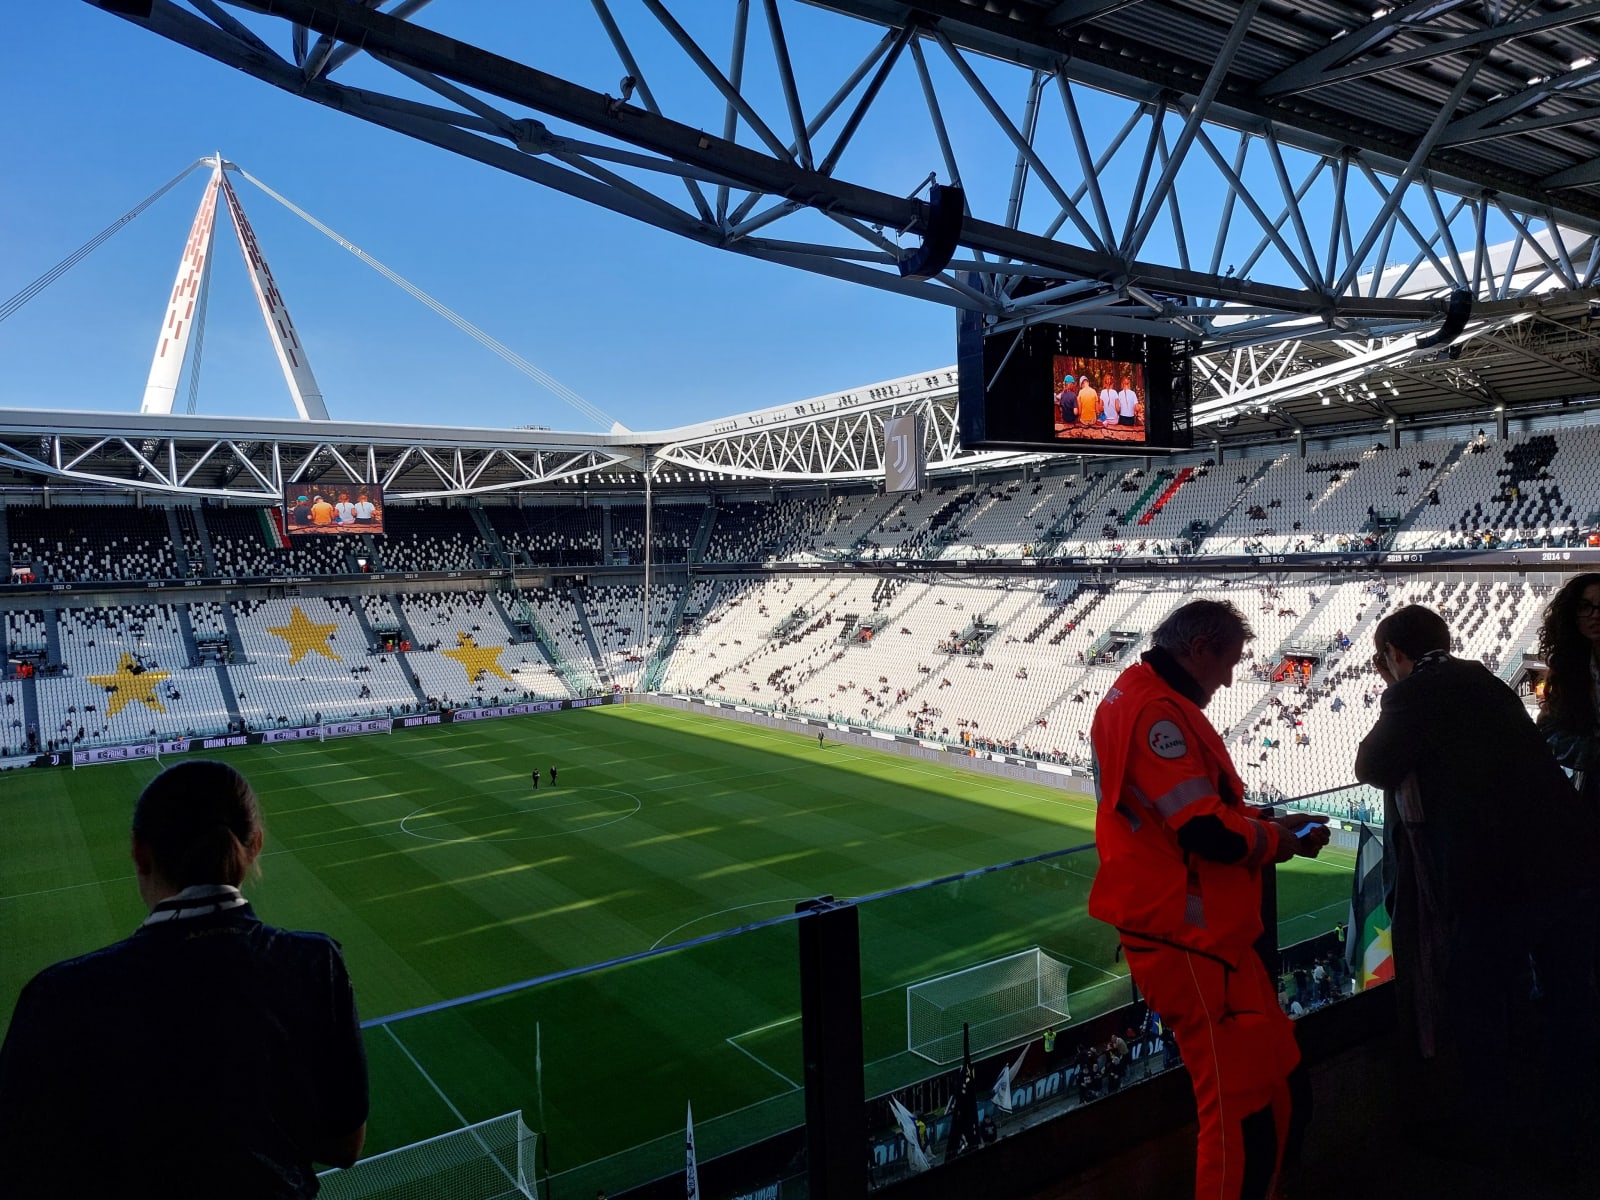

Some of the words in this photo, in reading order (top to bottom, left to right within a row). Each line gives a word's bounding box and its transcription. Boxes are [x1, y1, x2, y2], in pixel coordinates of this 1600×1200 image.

[1542, 553, 1560, 561] 2014
[404, 717, 423, 727] DRINK
[423, 715, 441, 725] PRIME
[203, 738, 226, 749] DRINK
[226, 735, 248, 746] PRIME
